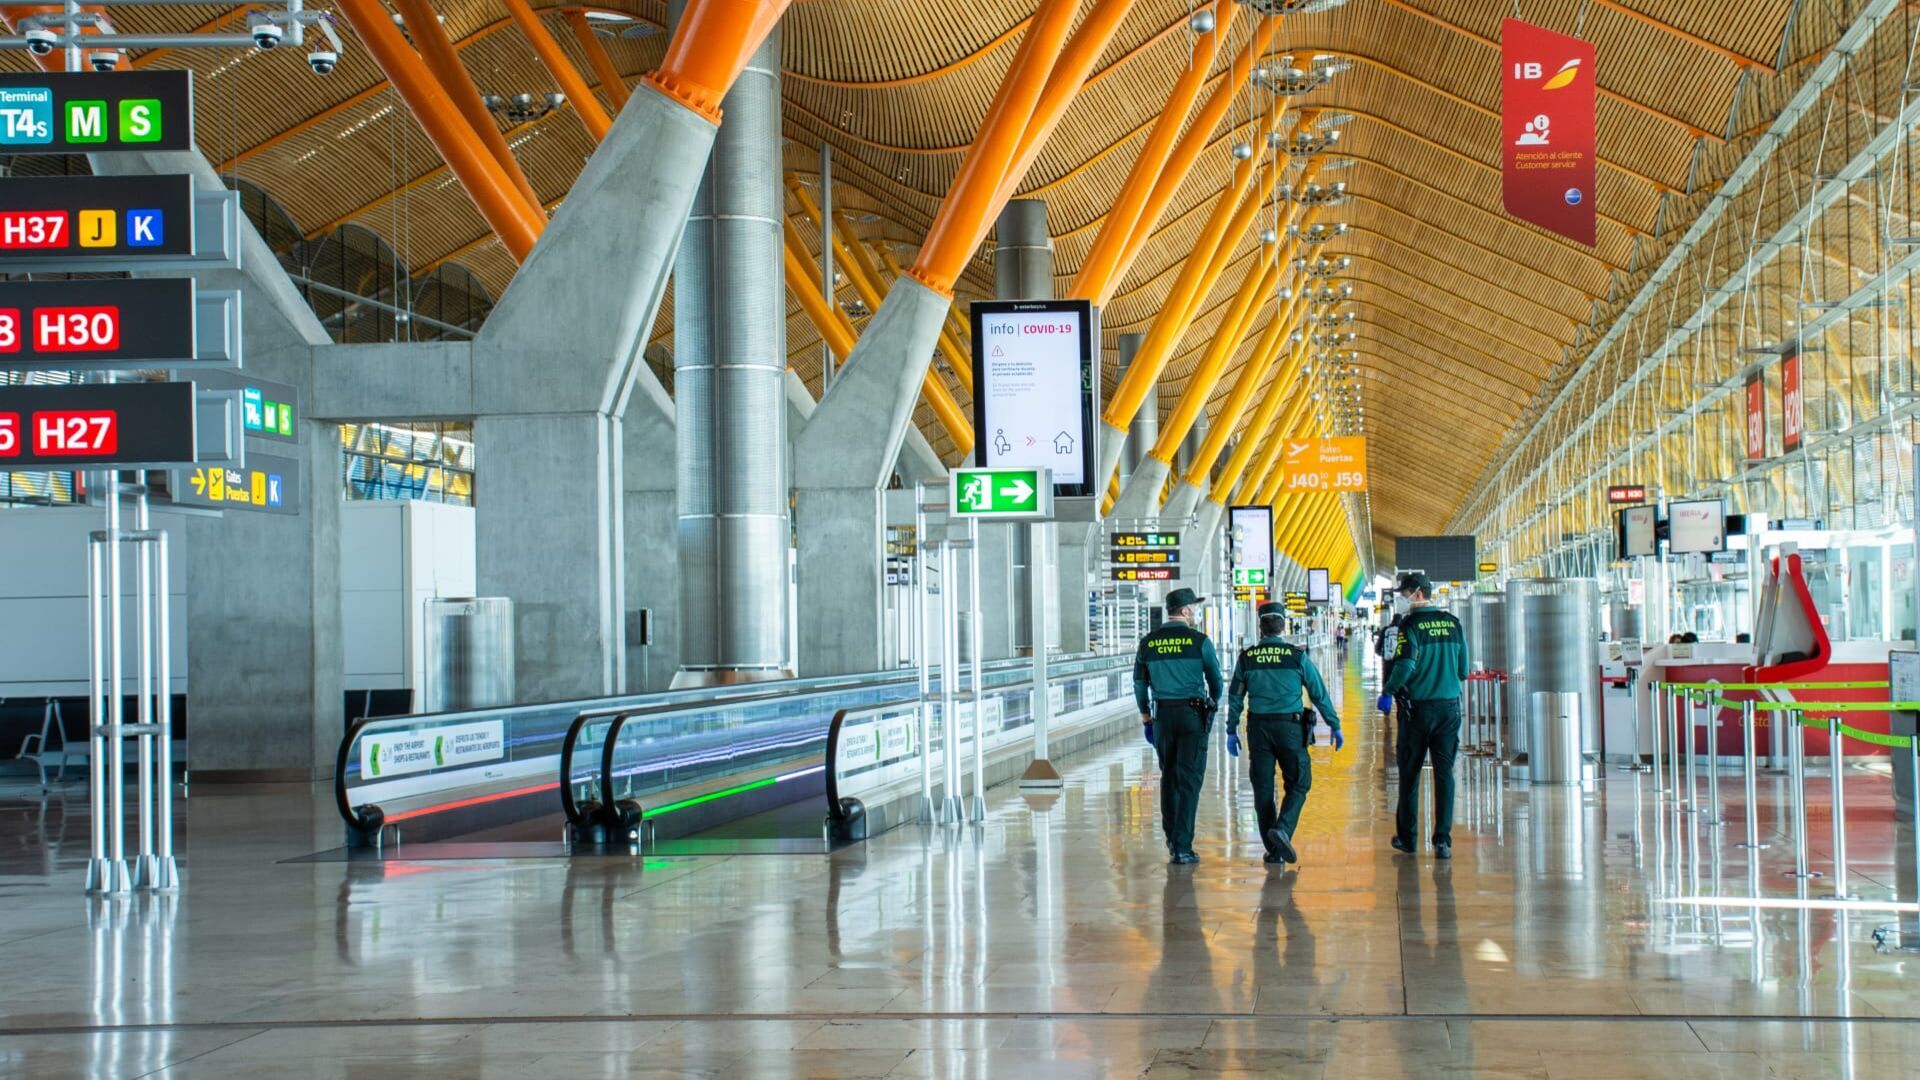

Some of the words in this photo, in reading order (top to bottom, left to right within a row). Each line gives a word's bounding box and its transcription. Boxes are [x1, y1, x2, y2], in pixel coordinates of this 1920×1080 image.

[1514, 63, 1542, 80] IB
[0, 91, 48, 102] Terminal
[71, 106, 101, 137] M
[129, 105, 152, 137] S
[1516, 152, 1548, 160] Atención
[1557, 151, 1583, 159] cliente
[1516, 161, 1551, 169] Customer
[4, 216, 65, 244] H37
[91, 217, 102, 241] J
[134, 216, 155, 241] K
[40, 312, 114, 346] H30
[990, 323, 1015, 335] info
[1023, 324, 1072, 334] COVID-19
[281, 408, 291, 432] S
[39, 417, 111, 450] H27
[1319, 454, 1354, 463] Puertas
[1288, 471, 1319, 489] J40
[1333, 472, 1363, 487] J59
[270, 480, 279, 502] K
[1417, 620, 1456, 630] GUARDIA
[1148, 637, 1193, 648] GUARDIA
[1157, 646, 1182, 654] CIVIL
[1247, 647, 1292, 657] GUARDIA
[1256, 655, 1281, 663] CIVIL
